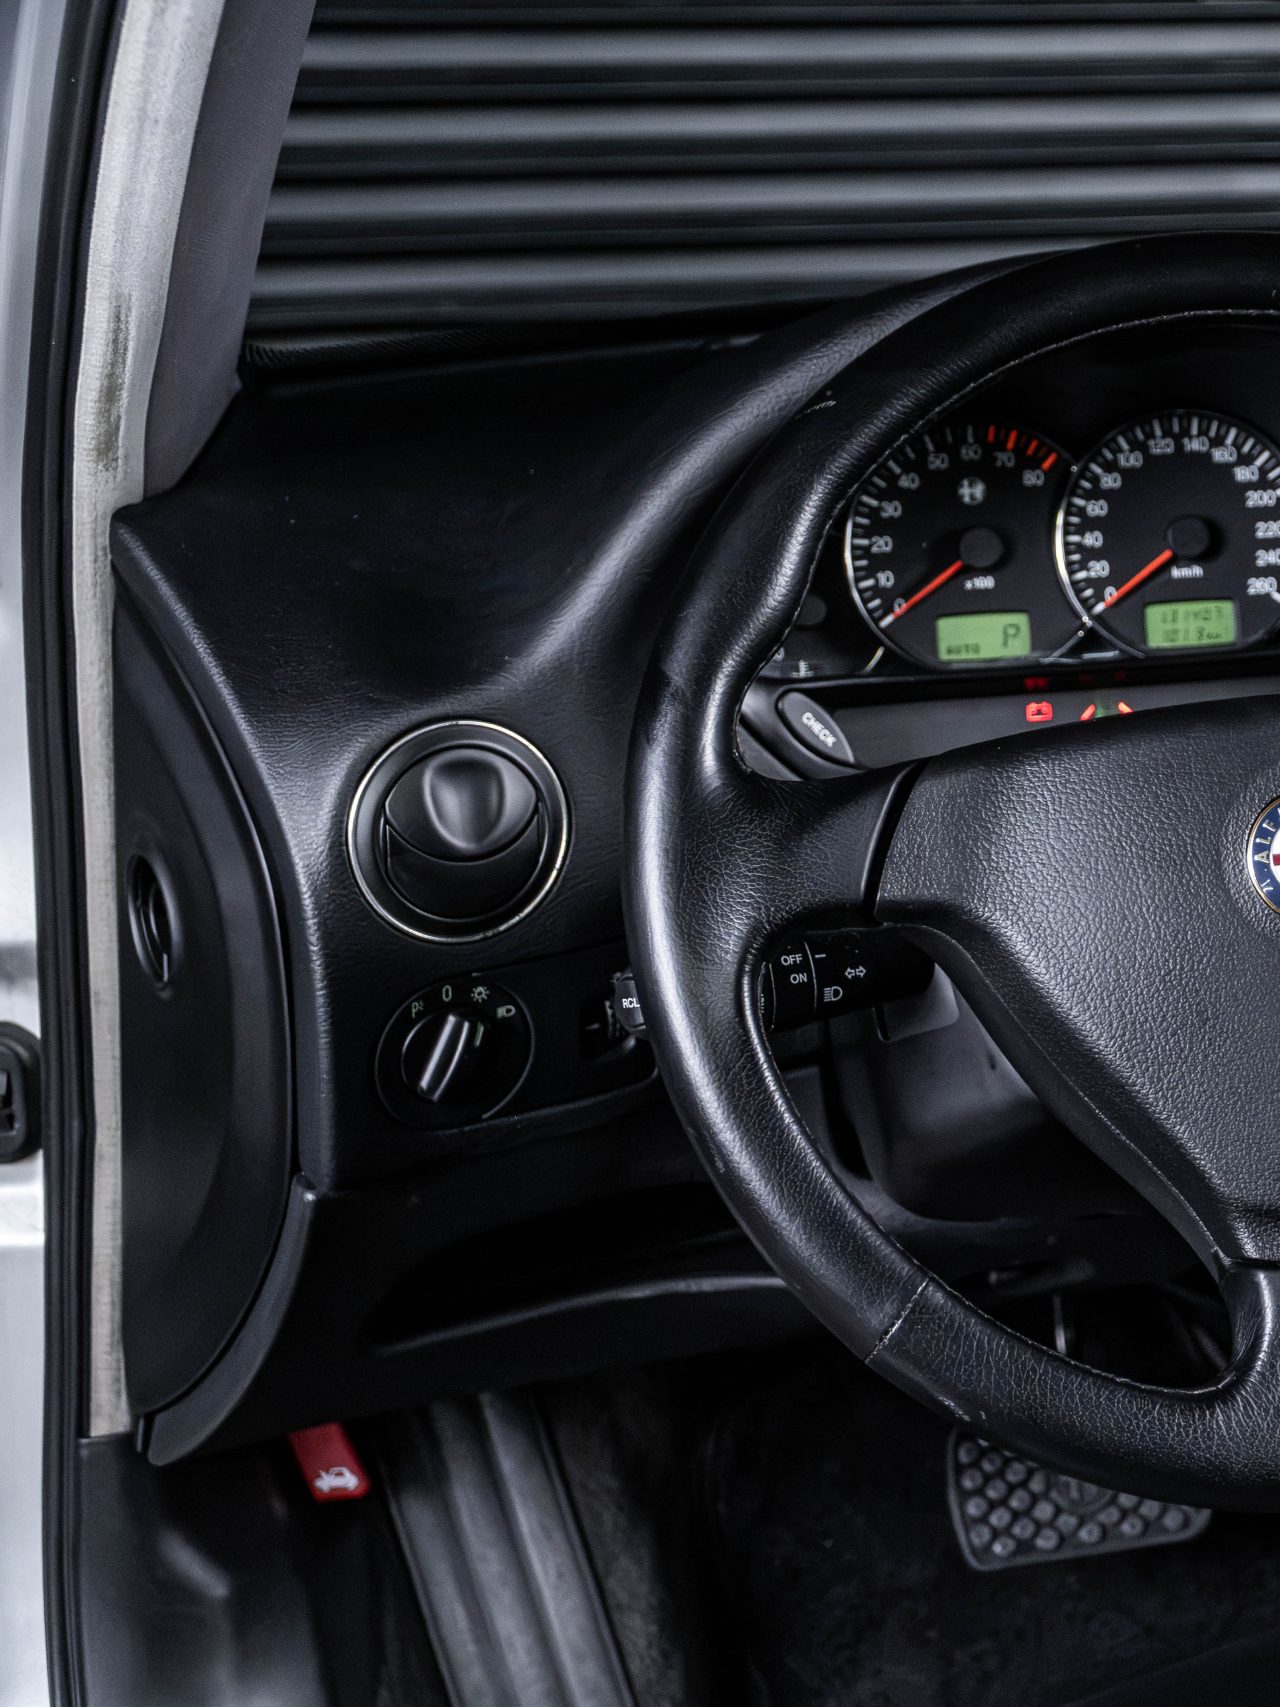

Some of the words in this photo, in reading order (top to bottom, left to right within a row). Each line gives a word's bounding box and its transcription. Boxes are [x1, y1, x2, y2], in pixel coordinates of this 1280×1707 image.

[1148, 437, 1174, 455] 120
[1182, 435, 1209, 452] 140
[1117, 450, 1143, 468] 100
[897, 472, 920, 490] 40
[1244, 489, 1276, 508] 200
[880, 500, 903, 518] 30
[1086, 499, 1109, 517] 60
[870, 535, 893, 553] 20
[1082, 530, 1104, 548] 40
[877, 568, 895, 587] 10
[1086, 559, 1110, 578] 20
[1246, 576, 1278, 596] 260
[1002, 622, 1020, 649] P
[801, 711, 838, 748] CHECK
[780, 953, 803, 966] OFF
[790, 973, 808, 984] ON
